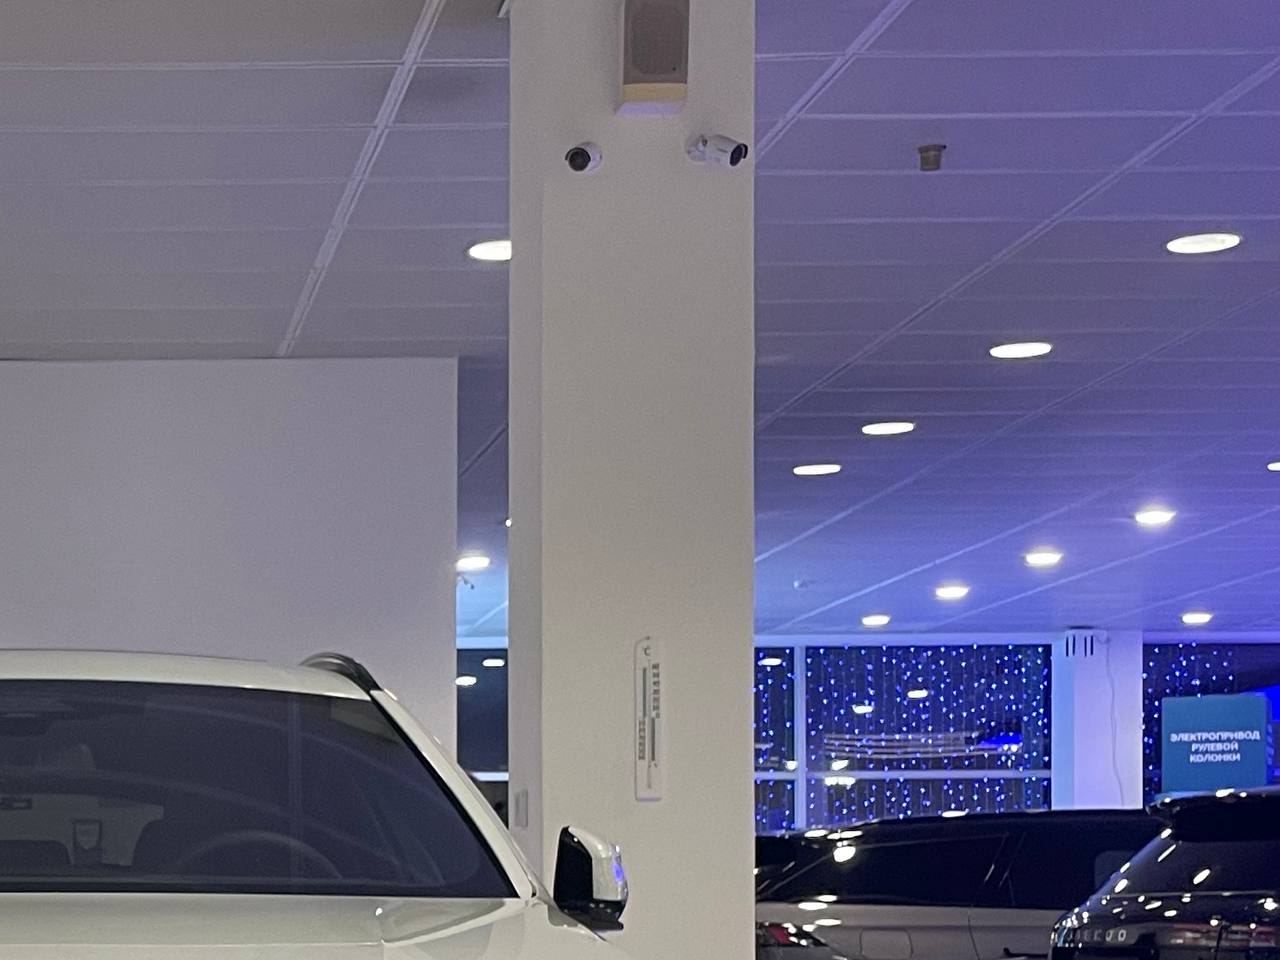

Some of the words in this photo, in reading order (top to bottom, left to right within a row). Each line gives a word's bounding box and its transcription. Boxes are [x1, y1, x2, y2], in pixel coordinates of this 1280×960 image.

[1170, 731, 1261, 743] ЭЛЕКТРОПРИВОД
[1191, 741, 1239, 752] РУЛЕВОЙ
[1189, 752, 1241, 763] КОЛОНКИ
